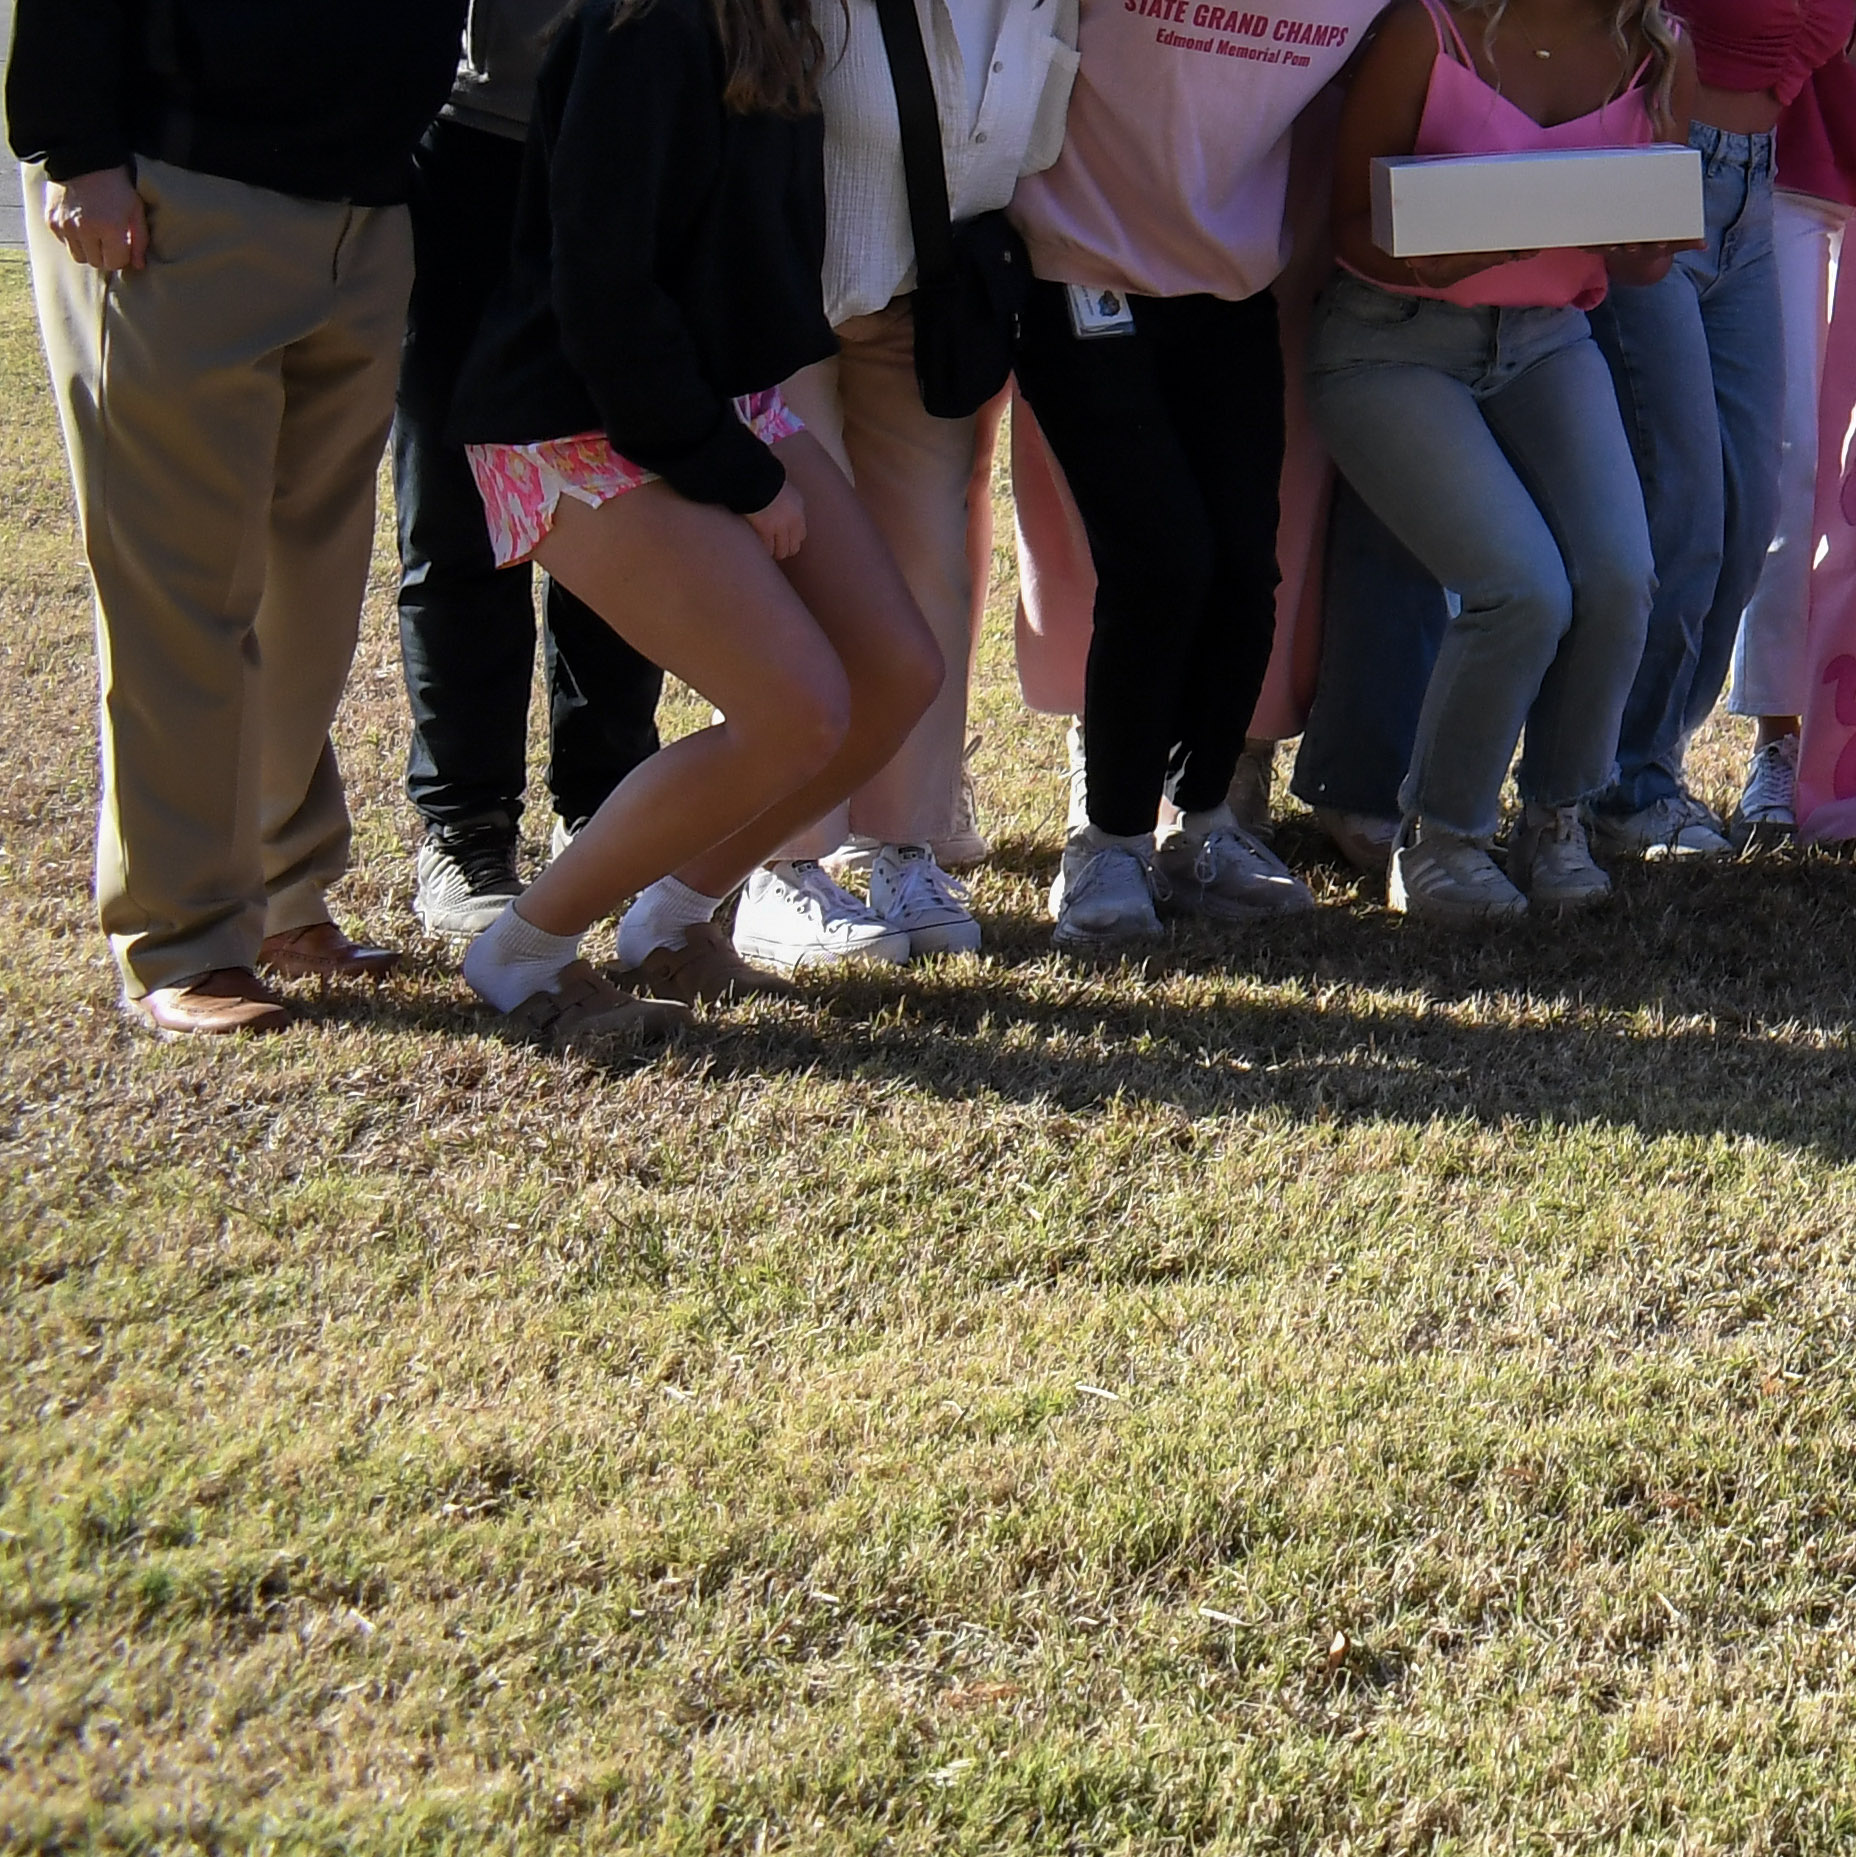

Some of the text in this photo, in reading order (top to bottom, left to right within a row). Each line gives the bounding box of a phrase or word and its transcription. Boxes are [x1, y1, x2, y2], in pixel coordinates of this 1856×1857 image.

[1192, 3, 1269, 38] GRAND
[1272, 19, 1350, 49] CHAMPS
[1155, 28, 1311, 68] Edmond Memorial Pom
